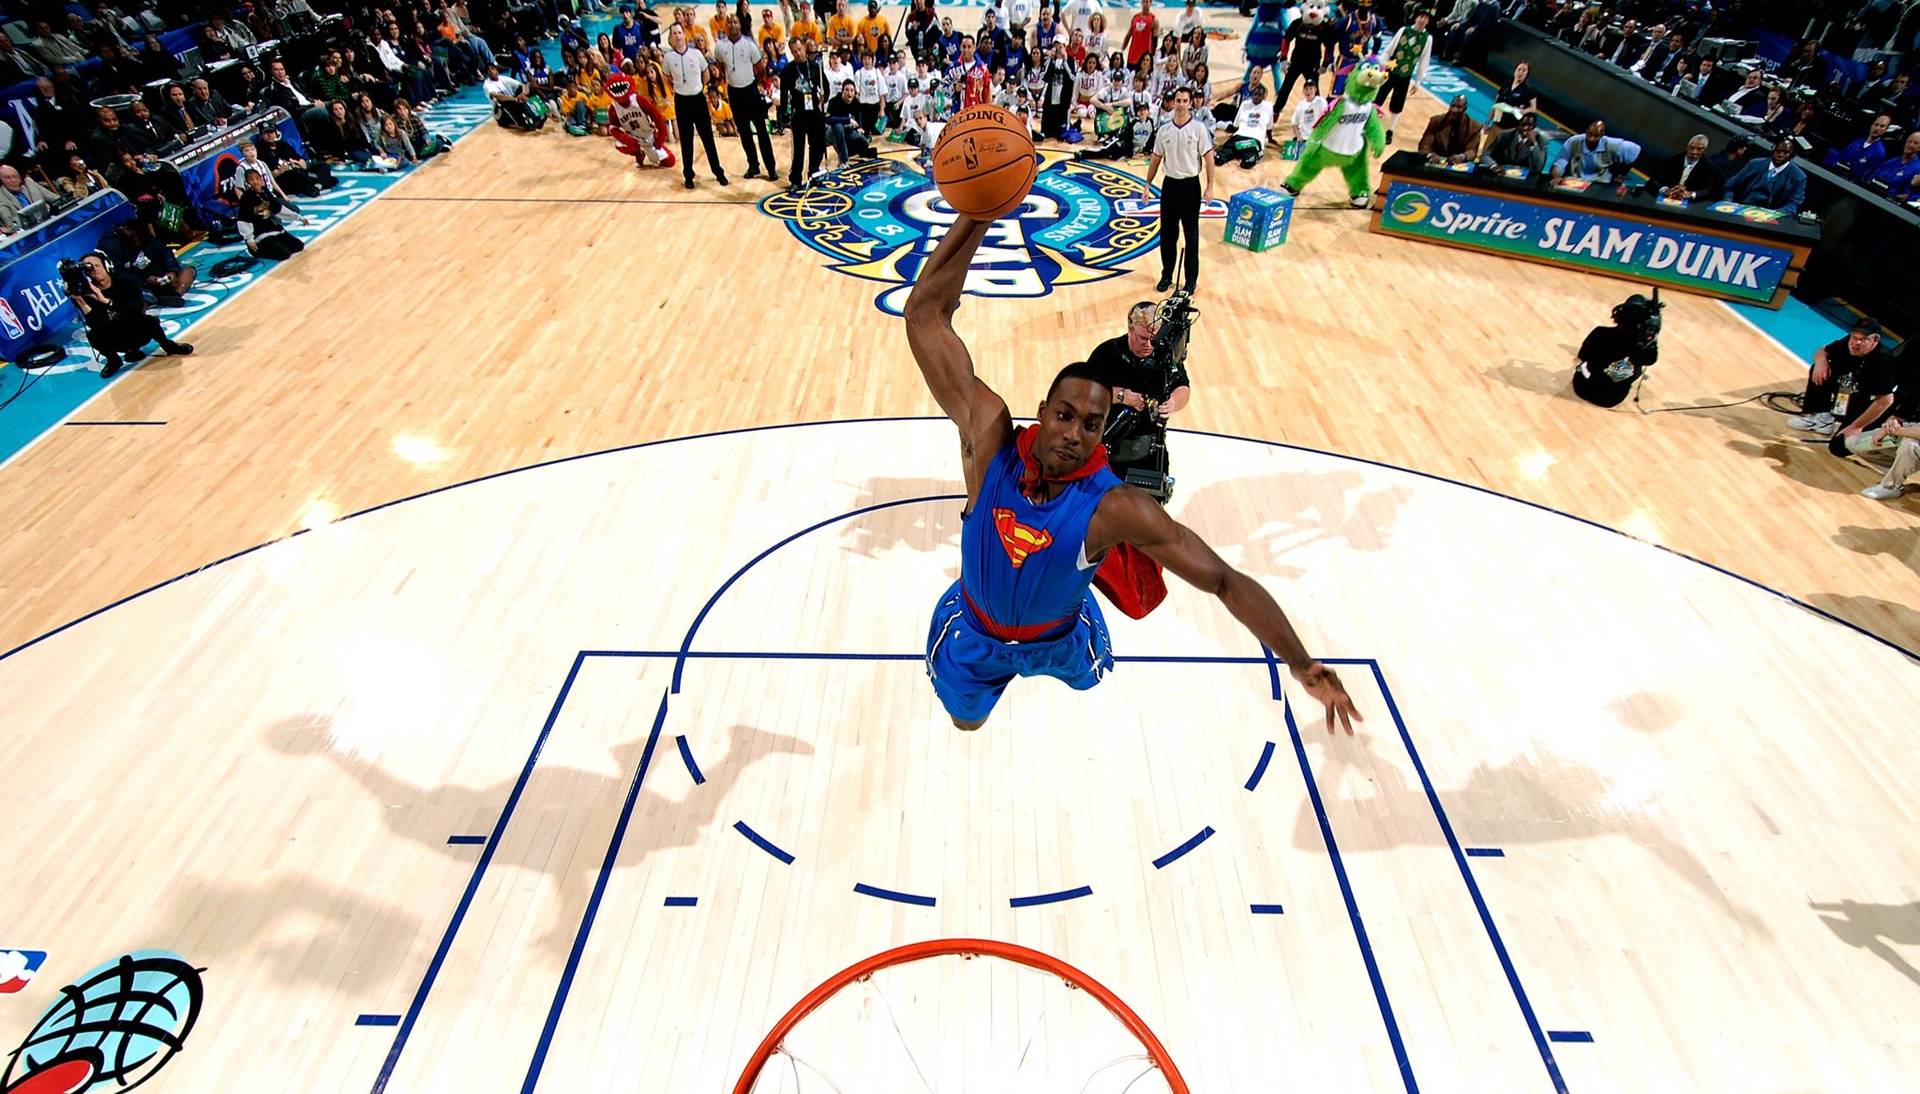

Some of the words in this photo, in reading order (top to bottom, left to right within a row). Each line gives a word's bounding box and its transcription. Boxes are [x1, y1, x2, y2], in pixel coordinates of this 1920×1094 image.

[1038, 176, 1089, 198] NEW
[1043, 197, 1101, 242] ORLEANS
[1231, 234, 1251, 247] DUNK
[1234, 226, 1252, 239] SLAM
[1430, 201, 1524, 239] Sprite
[1538, 217, 1643, 264] SLAM
[1646, 236, 1772, 290] DUNK
